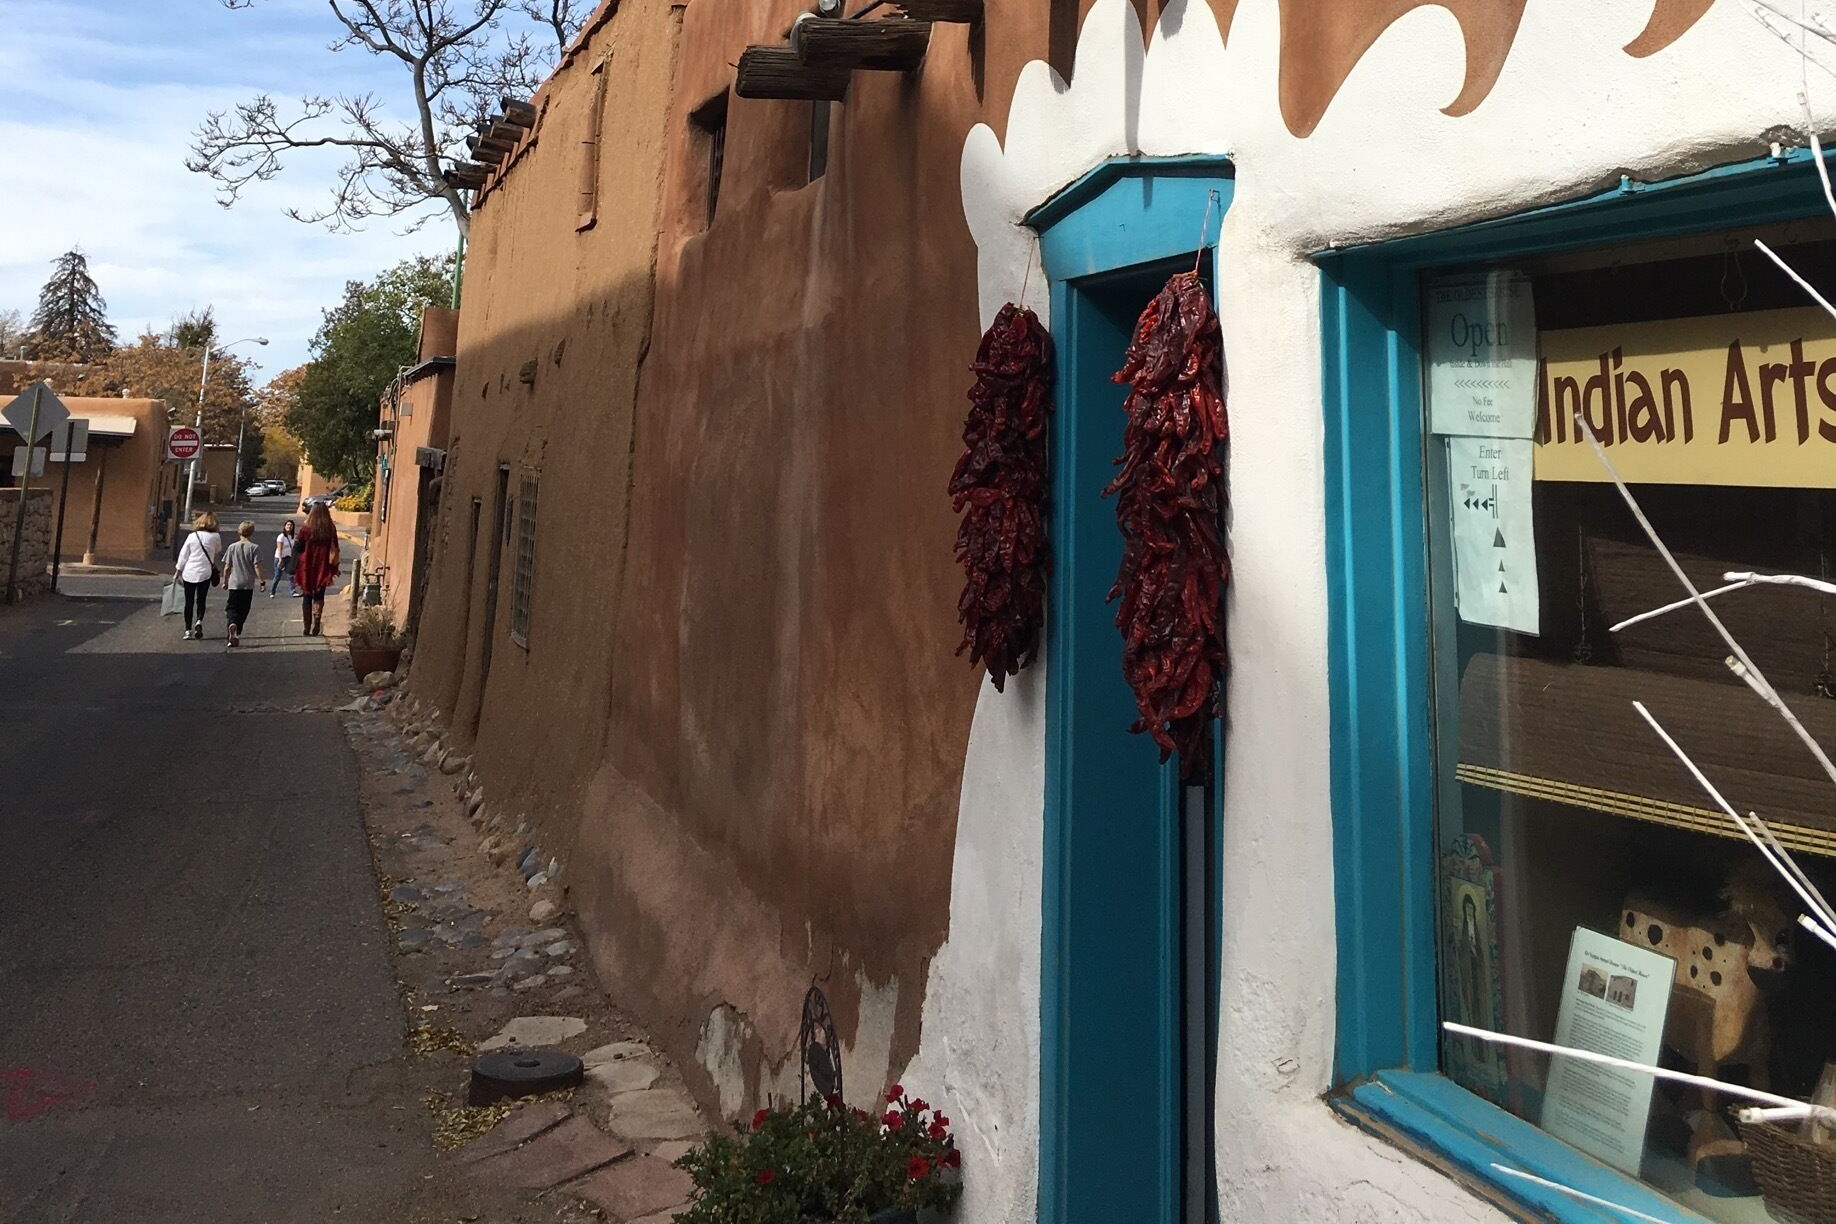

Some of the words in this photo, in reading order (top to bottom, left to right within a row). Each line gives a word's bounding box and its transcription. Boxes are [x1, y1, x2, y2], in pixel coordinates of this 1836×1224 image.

[1450, 312, 1509, 358] Open
[1538, 345, 1694, 448] Indian
[1717, 337, 1836, 447] Arts
[1472, 396, 1482, 406] No
[1468, 410, 1501, 423] Welcome
[1479, 445, 1502, 459] Enter
[1471, 465, 1489, 480] Turn
[1492, 466, 1509, 481] Left
